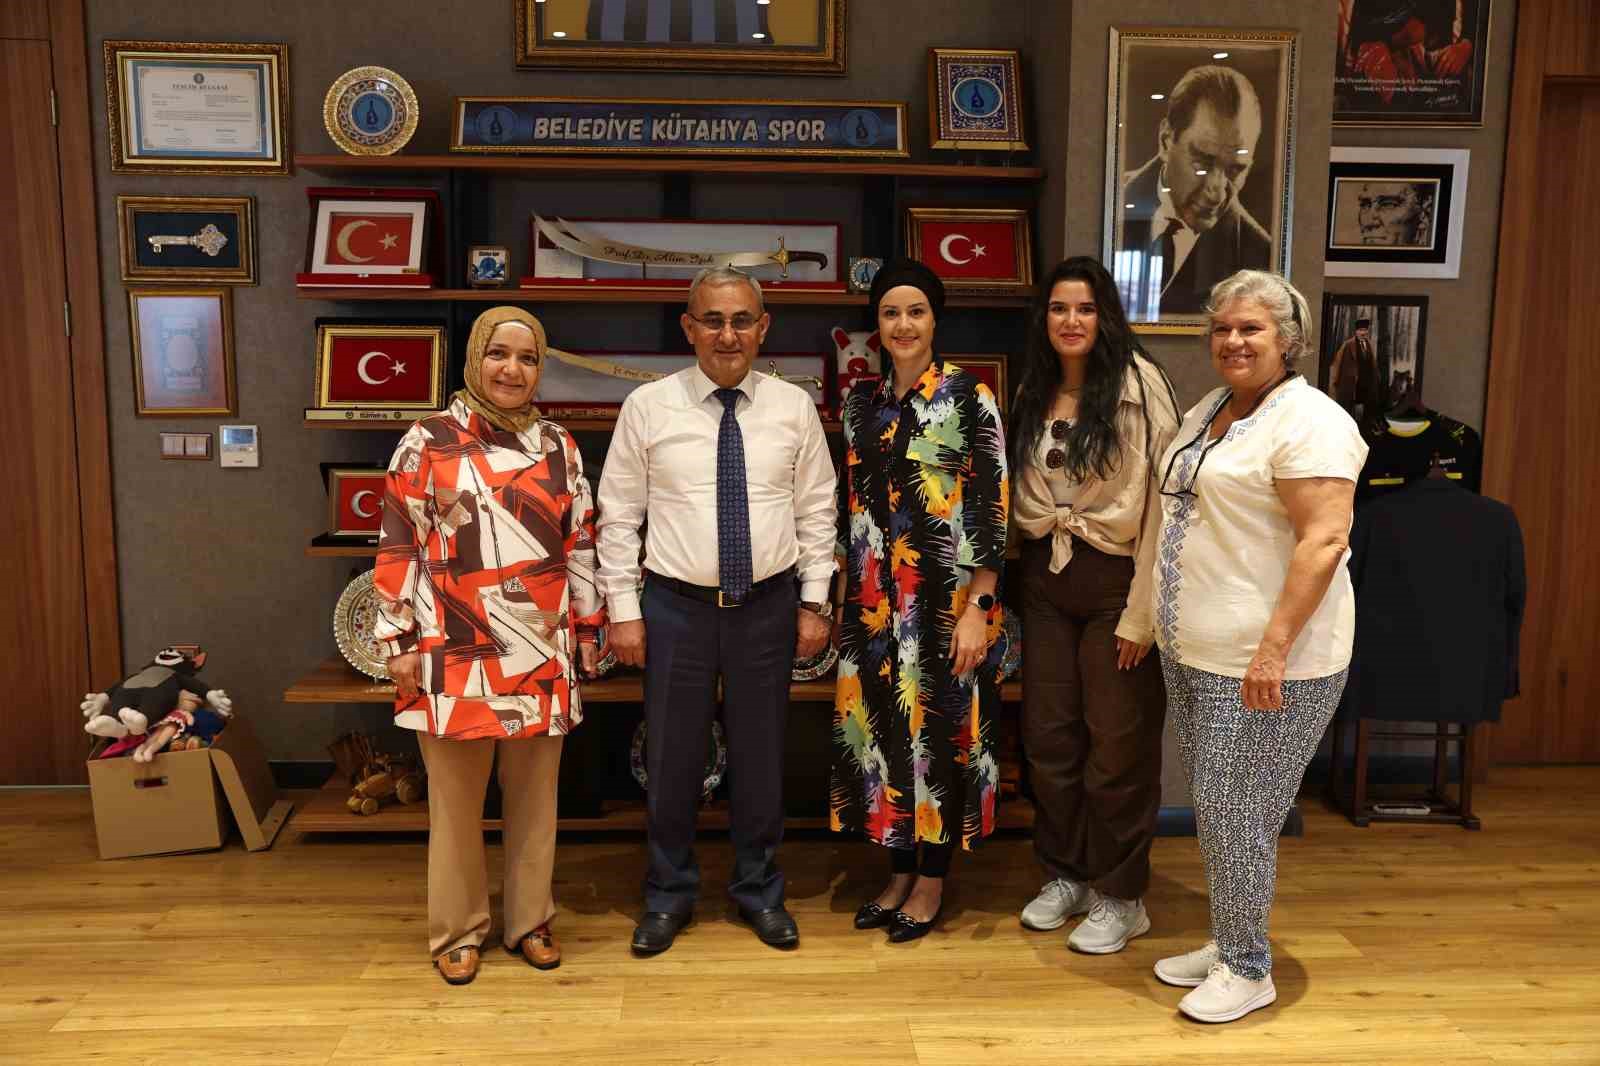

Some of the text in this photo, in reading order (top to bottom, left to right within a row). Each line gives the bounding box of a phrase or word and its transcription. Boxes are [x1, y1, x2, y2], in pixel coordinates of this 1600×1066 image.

[534, 112, 826, 143] BELEDİYE KÜTAHYA SPOR
